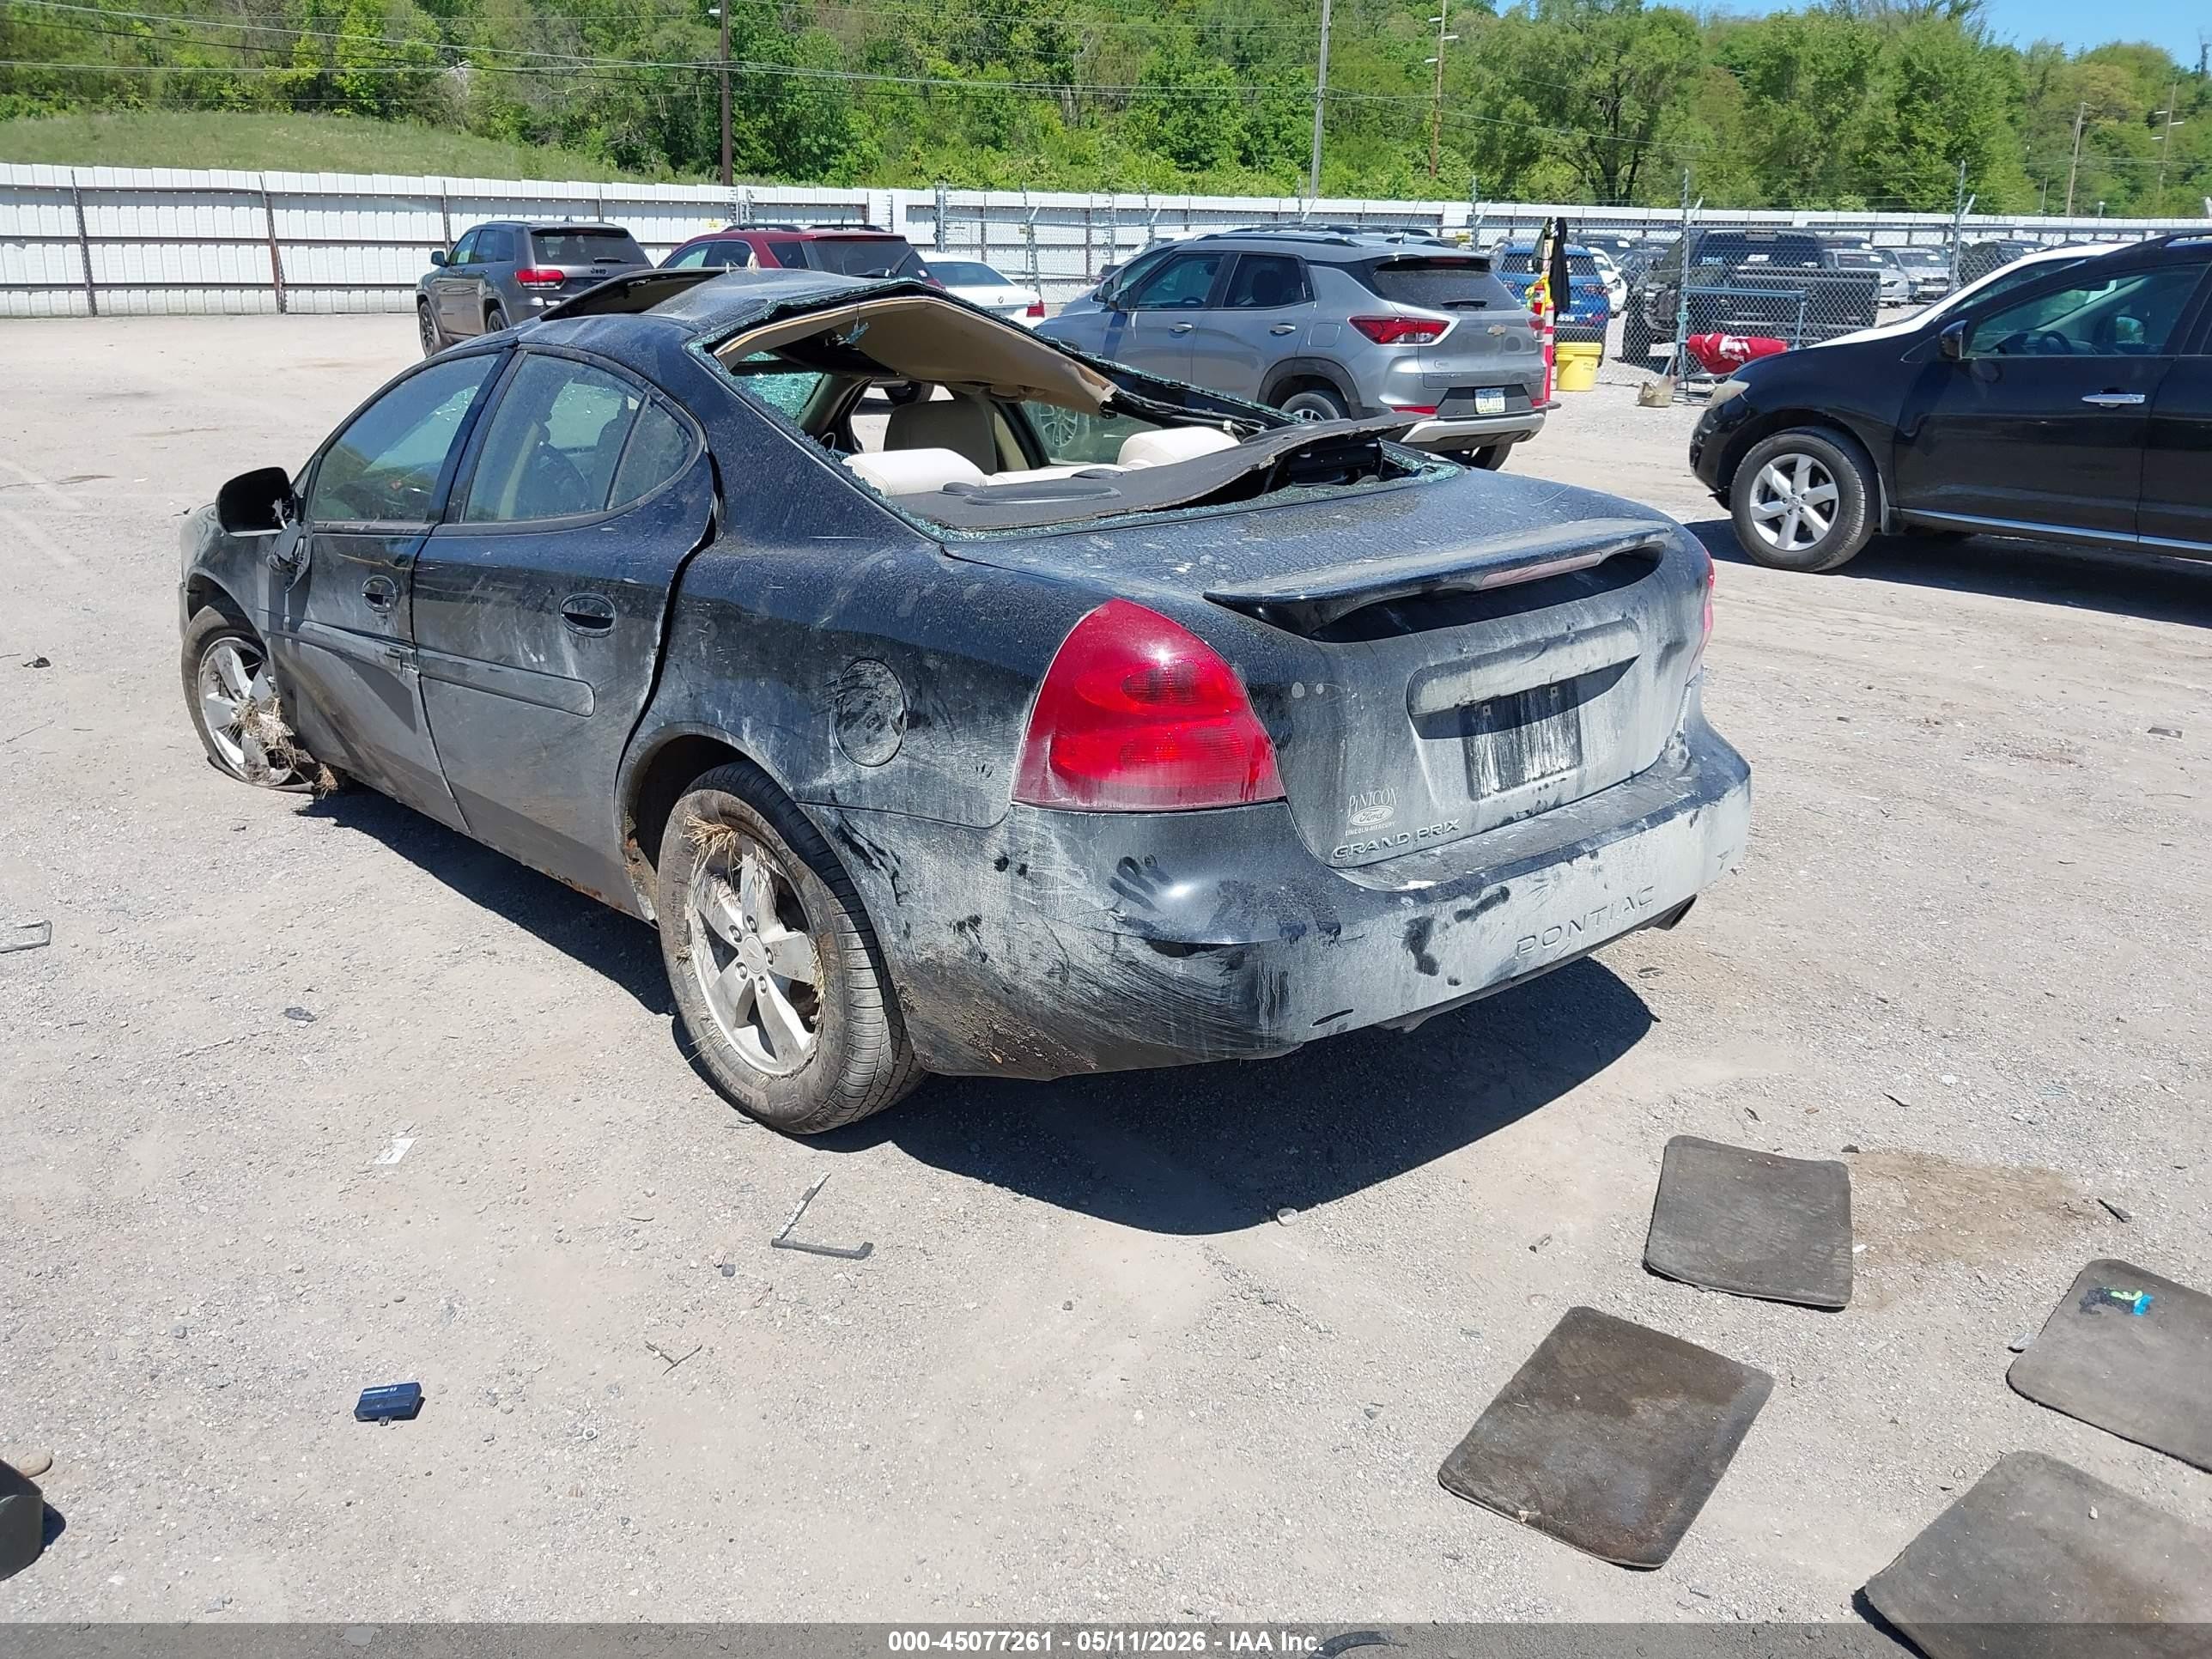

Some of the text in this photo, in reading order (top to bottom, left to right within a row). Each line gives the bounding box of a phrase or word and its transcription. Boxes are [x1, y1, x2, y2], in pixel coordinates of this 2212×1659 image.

[1359, 809, 1386, 822] Ford
[1333, 818, 1461, 859] GRAND PRIX
[1516, 885, 1654, 960] PONTIAC
